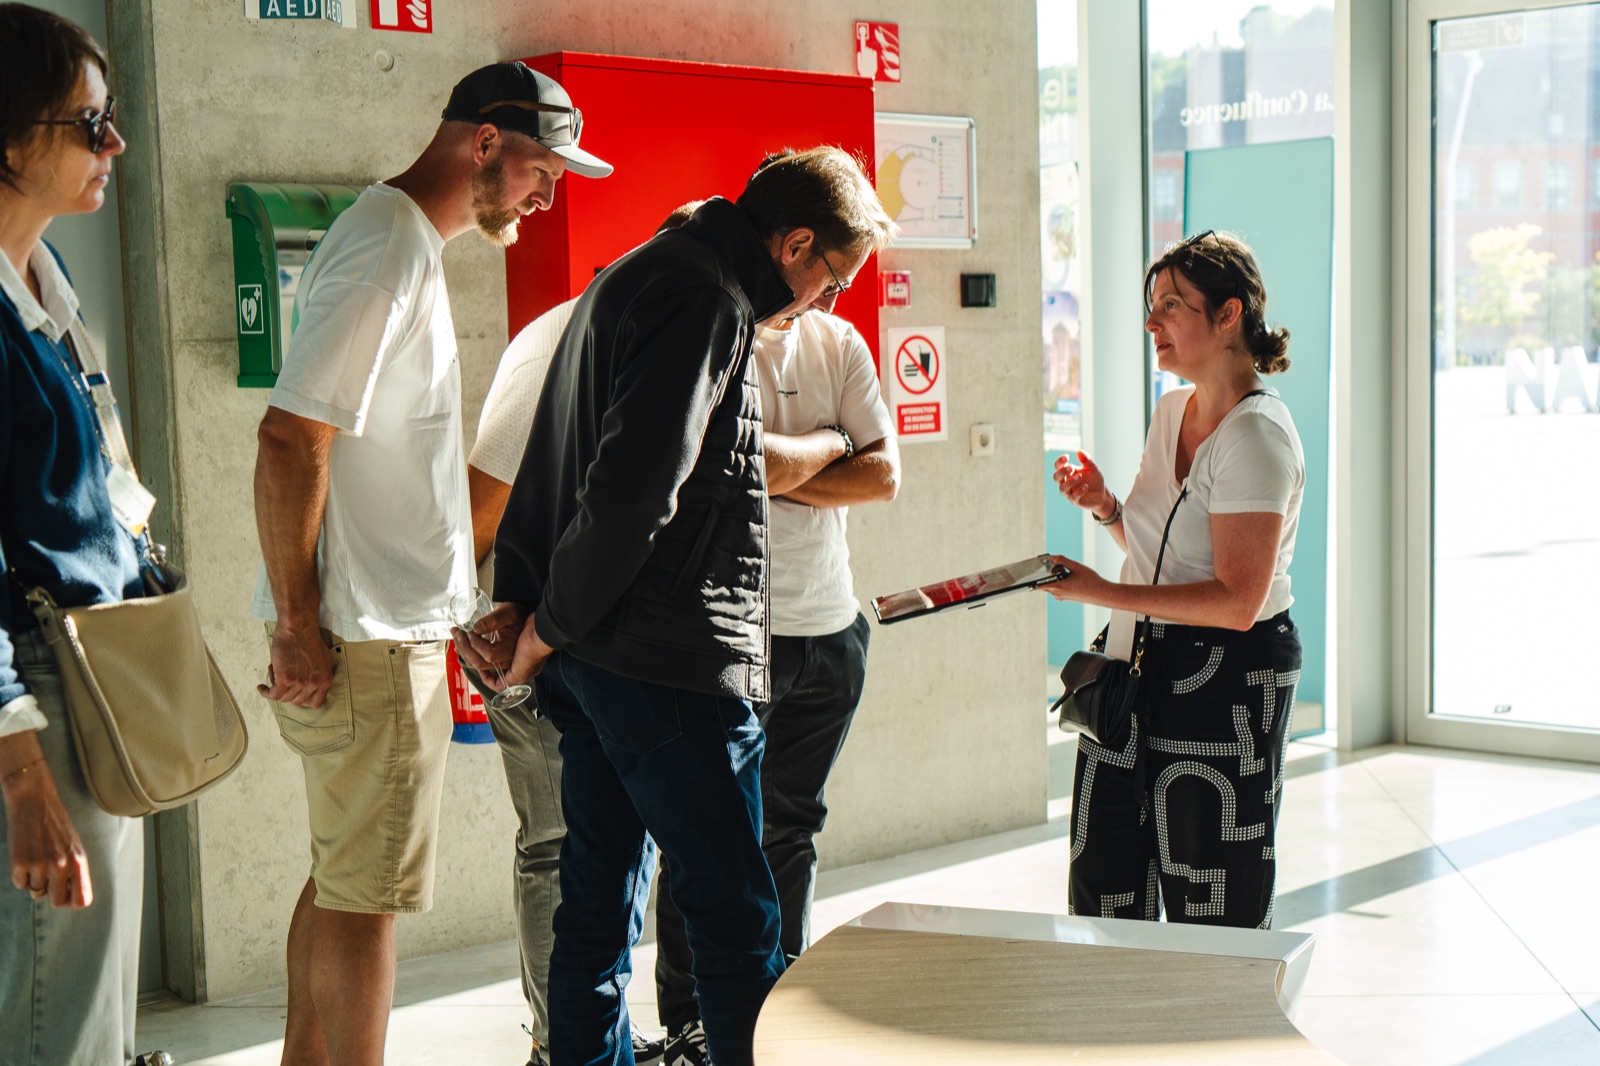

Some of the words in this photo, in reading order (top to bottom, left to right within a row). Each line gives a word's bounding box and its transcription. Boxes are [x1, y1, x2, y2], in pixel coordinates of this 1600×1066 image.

[266, 0, 317, 17] AED
[326, 0, 342, 23] AED
[1505, 345, 1600, 414] NA
[912, 414, 934, 422] MANGER
